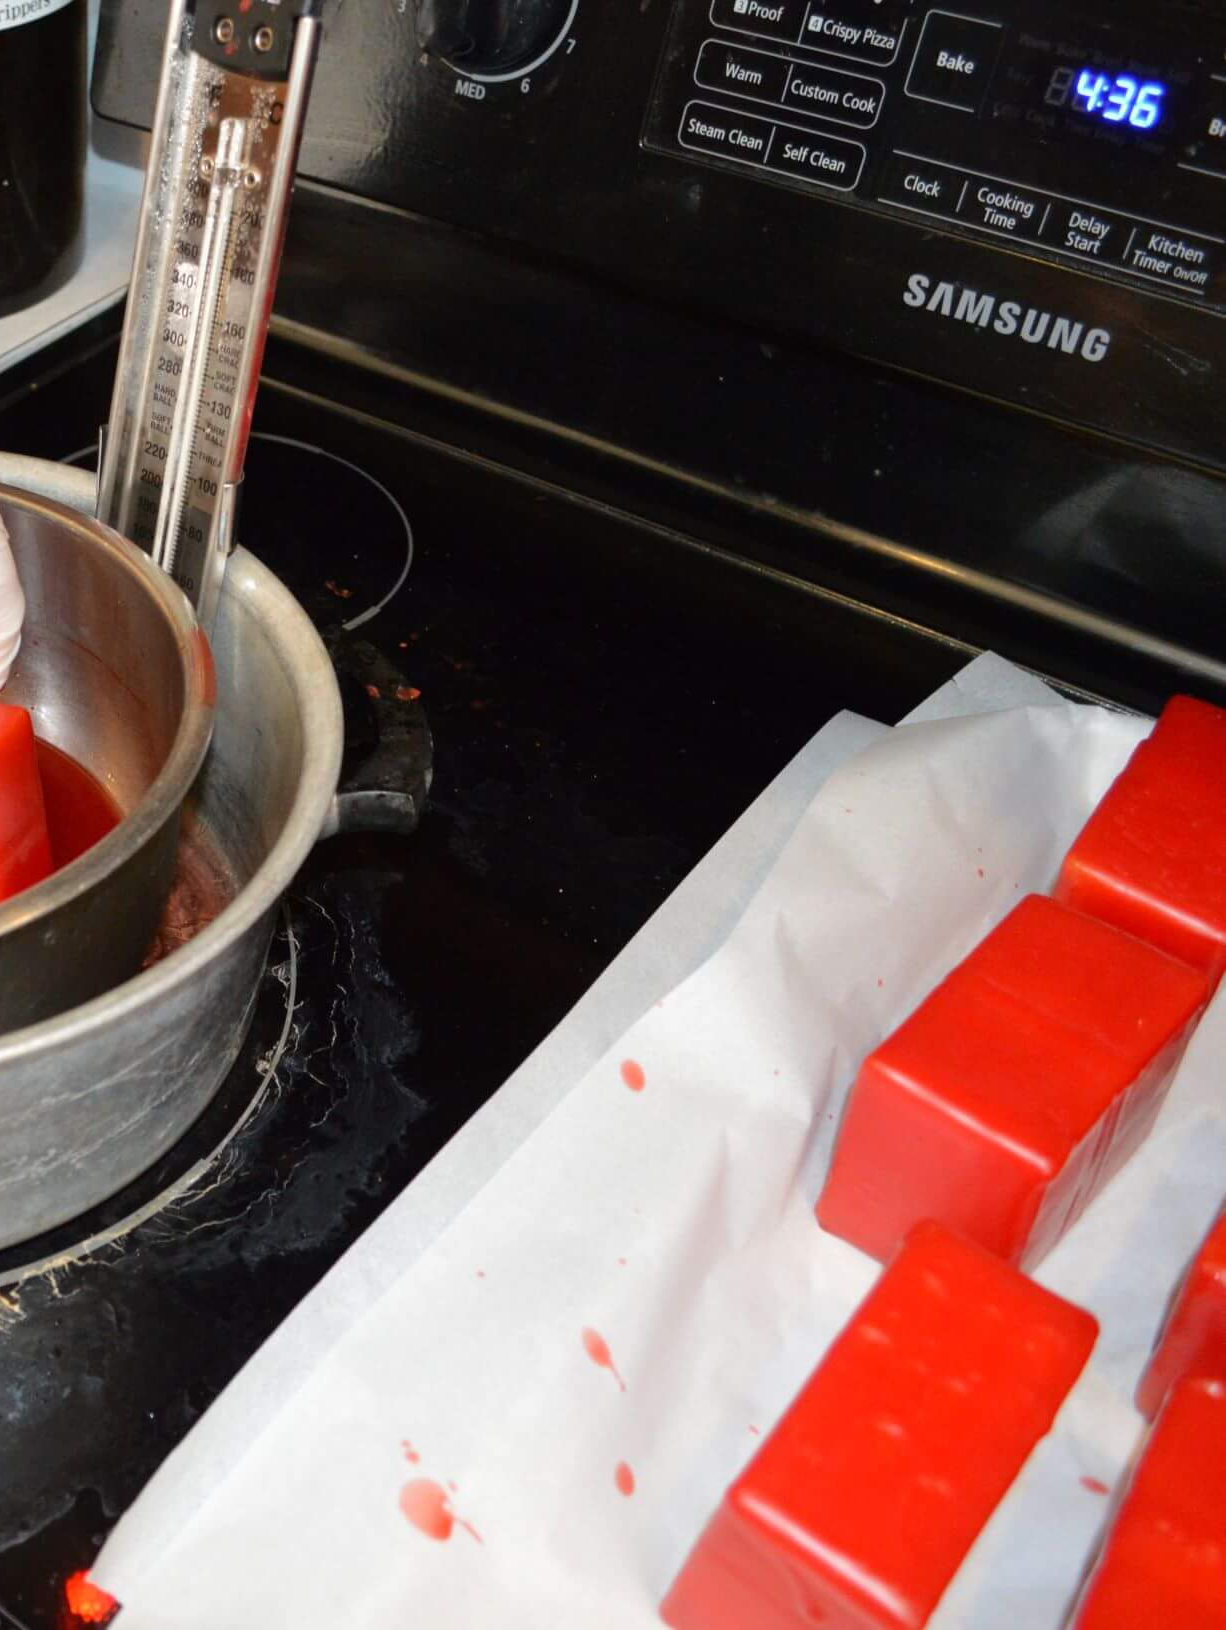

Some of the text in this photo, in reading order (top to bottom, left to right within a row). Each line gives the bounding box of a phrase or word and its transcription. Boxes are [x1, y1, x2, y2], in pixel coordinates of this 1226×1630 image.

[748, 3, 785, 22] Proof
[810, 17, 895, 49] 4 Crispy Pizza
[566, 38, 576, 54] 7
[725, 62, 762, 85] Warm
[936, 51, 974, 74] Bake
[454, 79, 486, 101] MED
[520, 78, 531, 93] 6
[790, 79, 876, 114] Custom Cook
[1076, 68, 1165, 129] 4:36
[687, 118, 763, 151] Steam Clean
[783, 143, 846, 174] Self Clean
[903, 174, 941, 198] Clock
[977, 186, 1034, 218] Cooking
[983, 207, 1016, 231] Time
[1068, 211, 1110, 239] Delay
[1065, 232, 1101, 255] Start
[1147, 234, 1204, 264] Kitchen
[172, 269, 194, 289] 340
[1132, 249, 1208, 286] Timer On/Off
[166, 299, 189, 318] 320
[903, 273, 1111, 363] SAMSUNG
[162, 328, 184, 347] 300
[224, 321, 246, 340] 160
[157, 356, 180, 376] 280
[211, 400, 232, 420] 130
[144, 441, 166, 460] 220
[140, 468, 162, 488] 200
[199, 478, 218, 497] 100
[188, 526, 203, 543] 80
